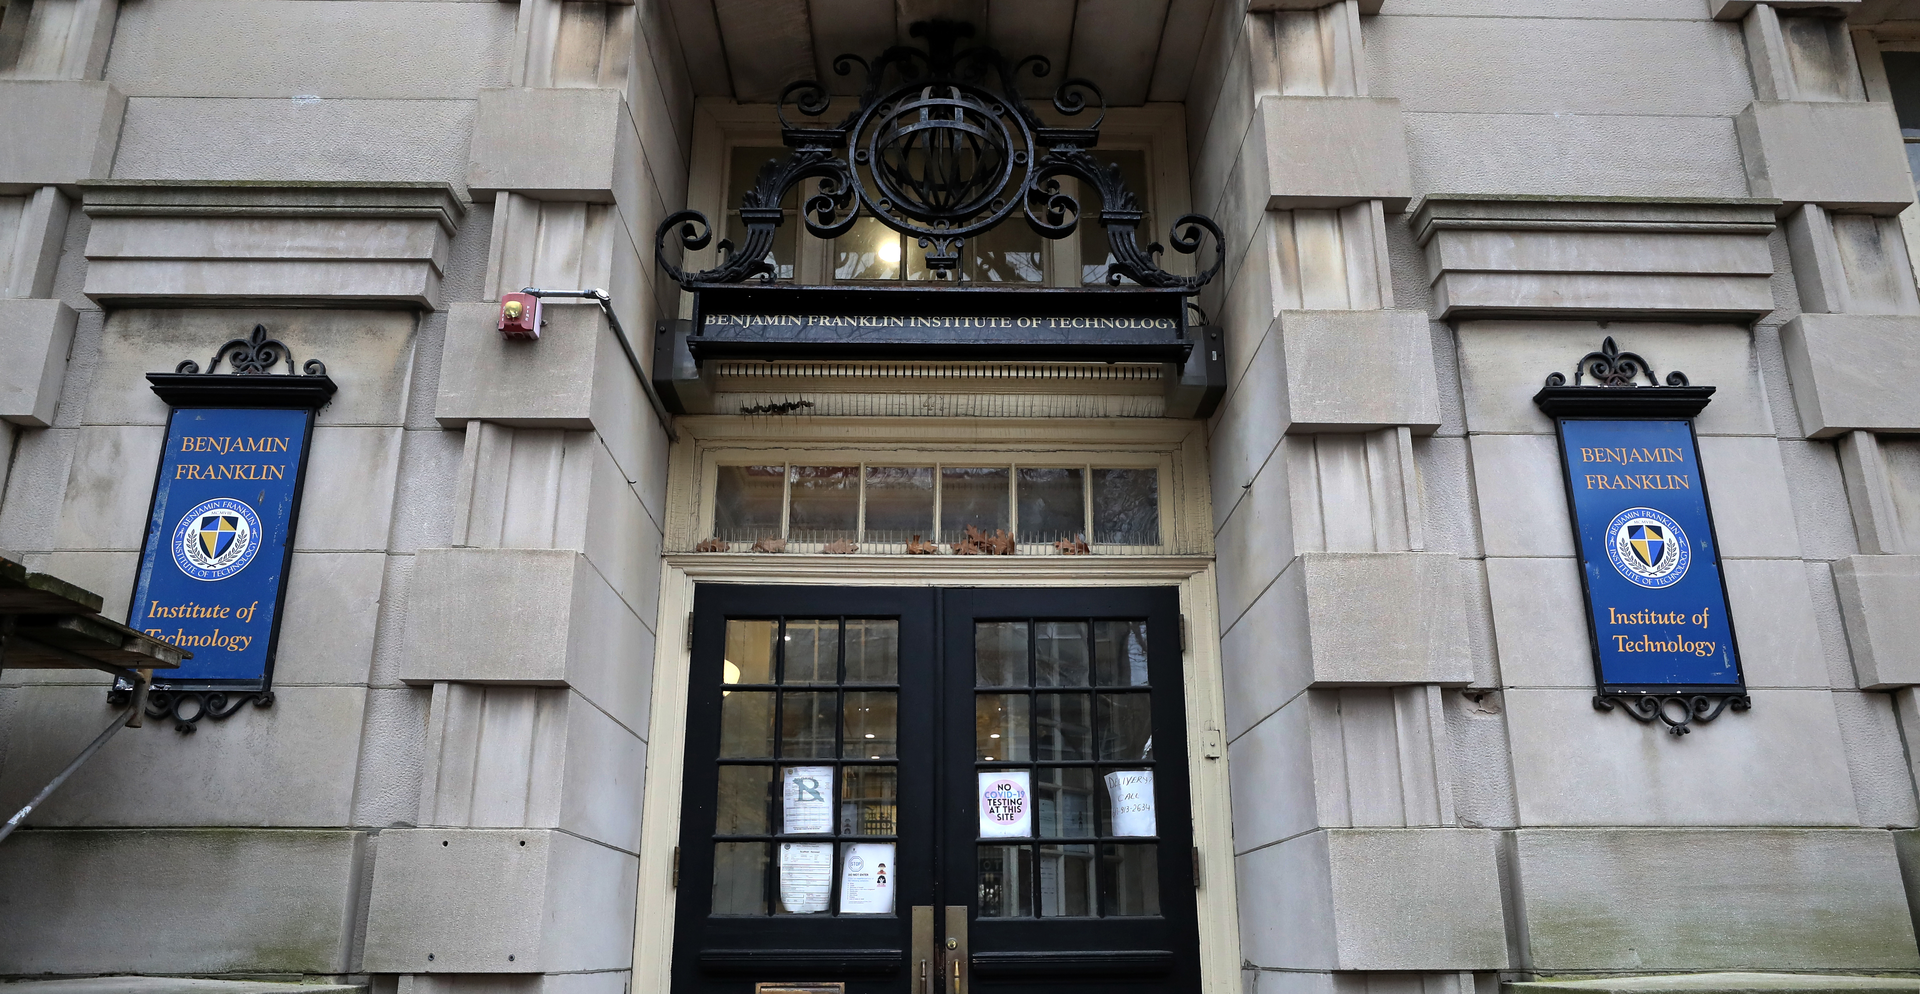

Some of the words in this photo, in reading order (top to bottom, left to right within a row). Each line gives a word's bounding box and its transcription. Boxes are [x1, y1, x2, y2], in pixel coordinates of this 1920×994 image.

[704, 314, 802, 328] BENJAMIN
[807, 315, 904, 327] FRANKLIN
[910, 316, 1012, 328] INSTITUTE
[1017, 317, 1042, 328] OF
[1046, 317, 1180, 329] TECHNOLOGY
[181, 436, 290, 455] BENJAMIN
[1580, 447, 1684, 466] BENJAMIN
[174, 464, 285, 480] FRANKLIN
[1584, 474, 1690, 490] FRANKLIN
[182, 501, 220, 527] BENJAMIN
[222, 501, 257, 526] FRANKLIN
[1610, 510, 1640, 536] BENJAMIN
[1641, 510, 1680, 535] FRANKLIN
[175, 540, 198, 575] INSTITUTE
[197, 570, 210, 578] OF
[212, 541, 257, 578] TECHNOLOGY
[1610, 548, 1641, 583] INSTITUTE
[1656, 549, 1687, 585] TECHNOLOGY
[147, 600, 230, 618] Institute
[236, 601, 258, 622] of
[1608, 607, 1686, 625] Institute
[1692, 607, 1710, 628] of
[143, 628, 252, 652] Technology
[1612, 635, 1716, 657] Technology
[984, 790, 1025, 798] COVID-19
[997, 783, 1012, 791] NO
[987, 798, 1023, 806] TESTING
[1117, 792, 1139, 802] CALL
[997, 813, 1015, 821] SITE
